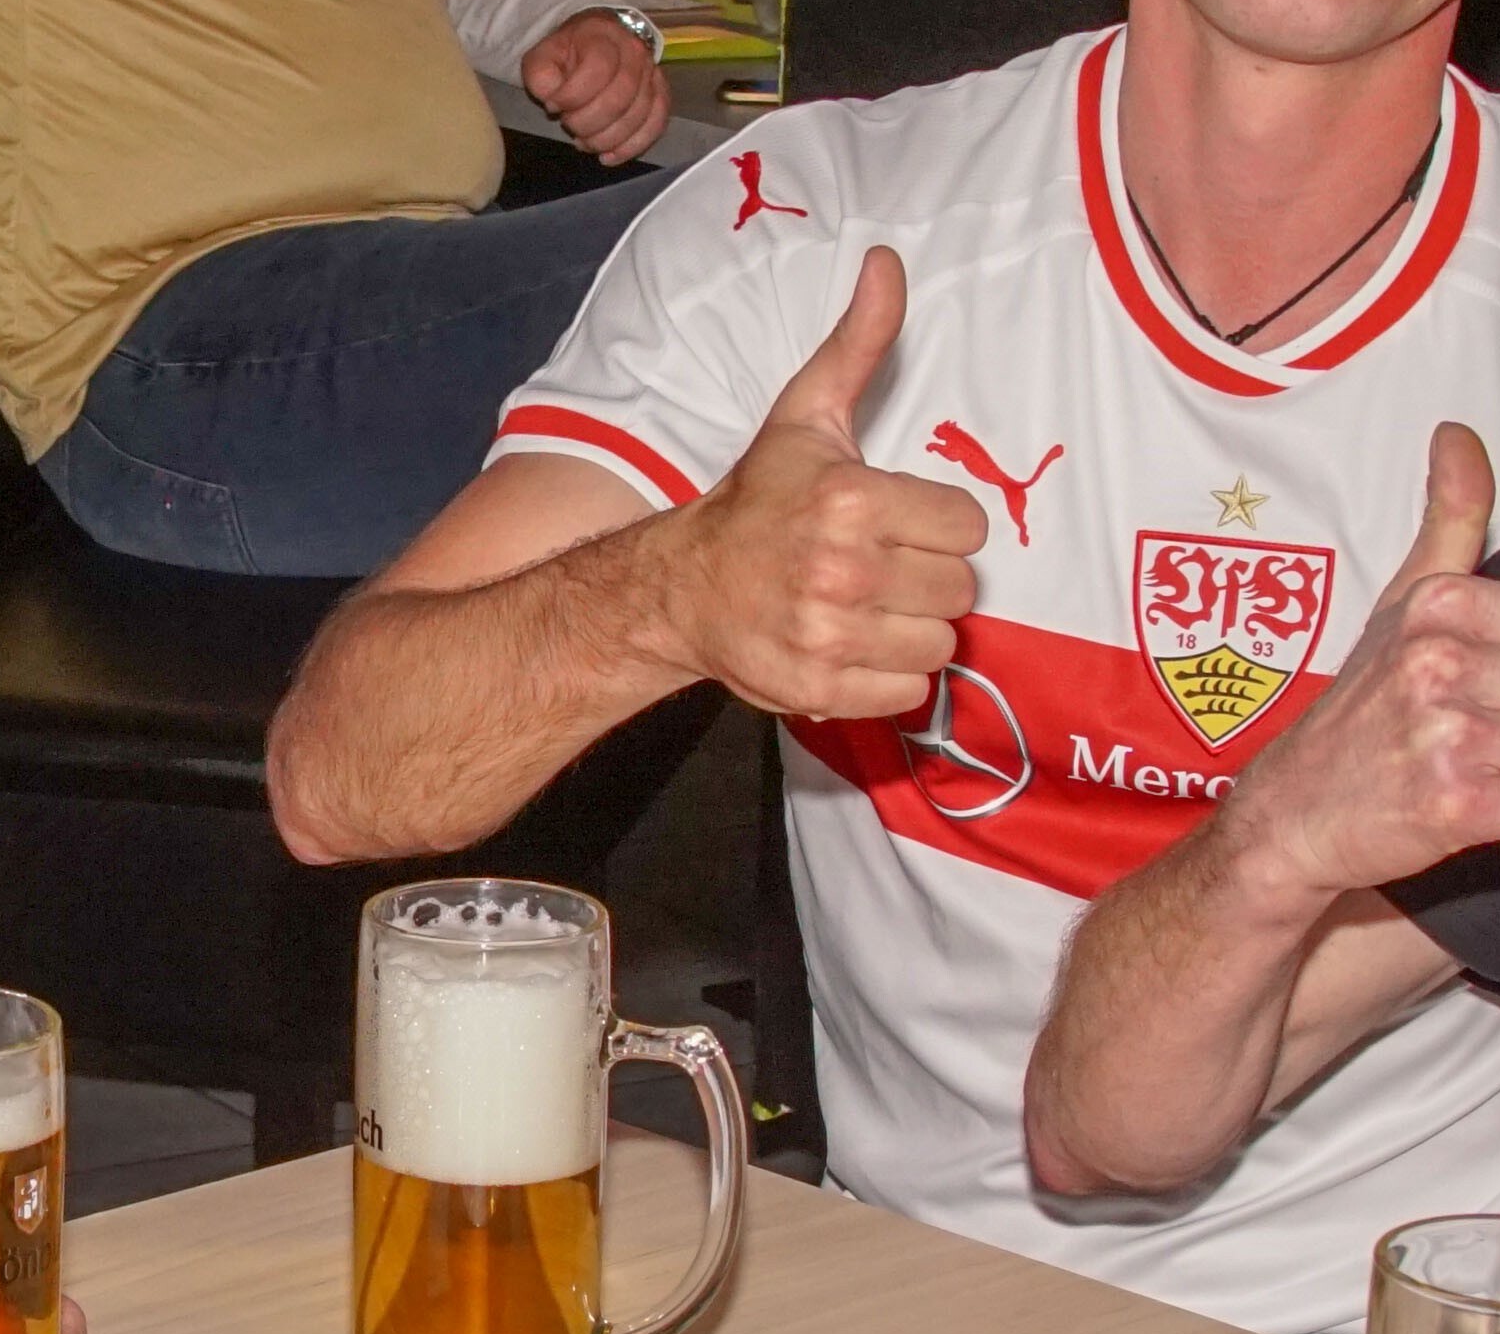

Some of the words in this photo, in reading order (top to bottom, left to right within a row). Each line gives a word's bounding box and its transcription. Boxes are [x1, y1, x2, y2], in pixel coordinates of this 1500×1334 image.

[1176, 631, 1198, 651] 18
[1251, 639, 1275, 659] 93
[1068, 734, 1236, 800] Merc
